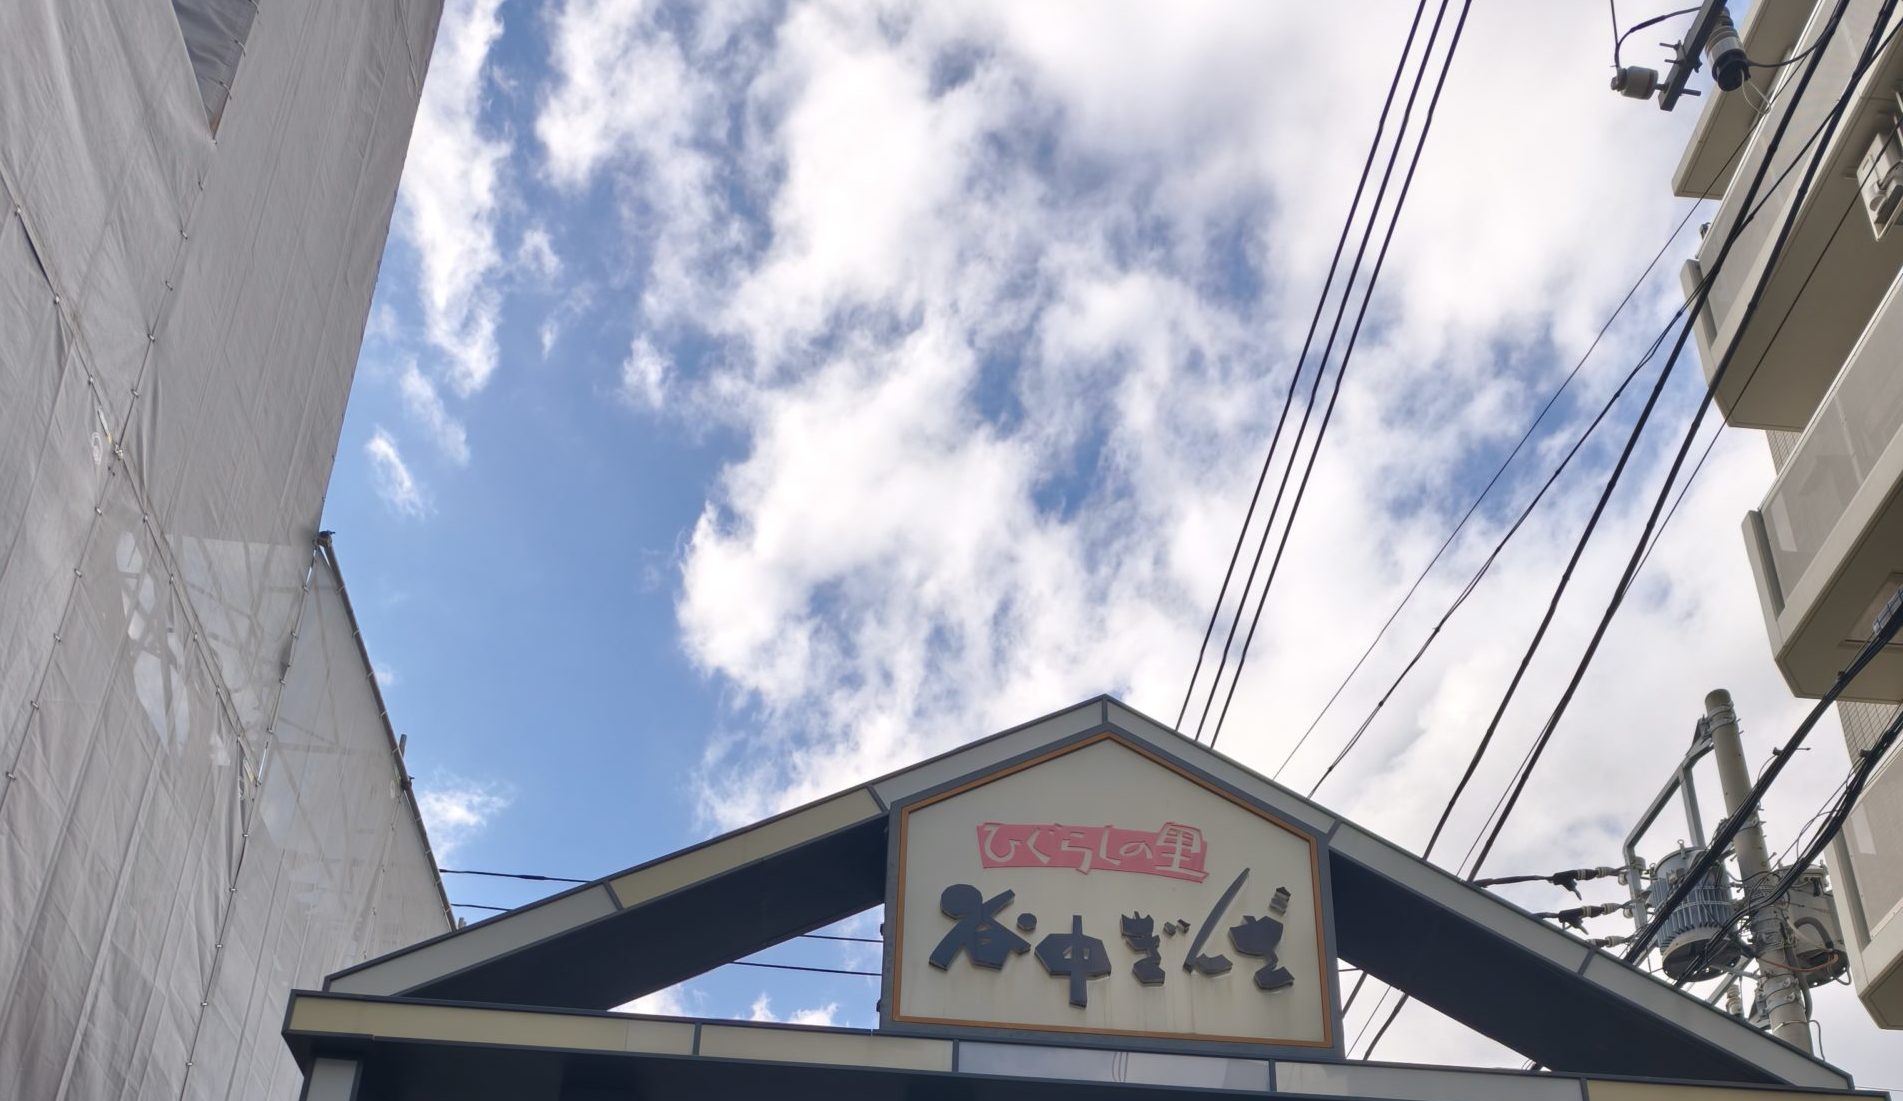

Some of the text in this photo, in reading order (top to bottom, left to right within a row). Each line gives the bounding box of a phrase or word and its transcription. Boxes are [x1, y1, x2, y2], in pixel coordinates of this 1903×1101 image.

[983, 822, 1208, 882] ひぐらしの里
[928, 867, 1295, 1008] 谷中ぎんざ
